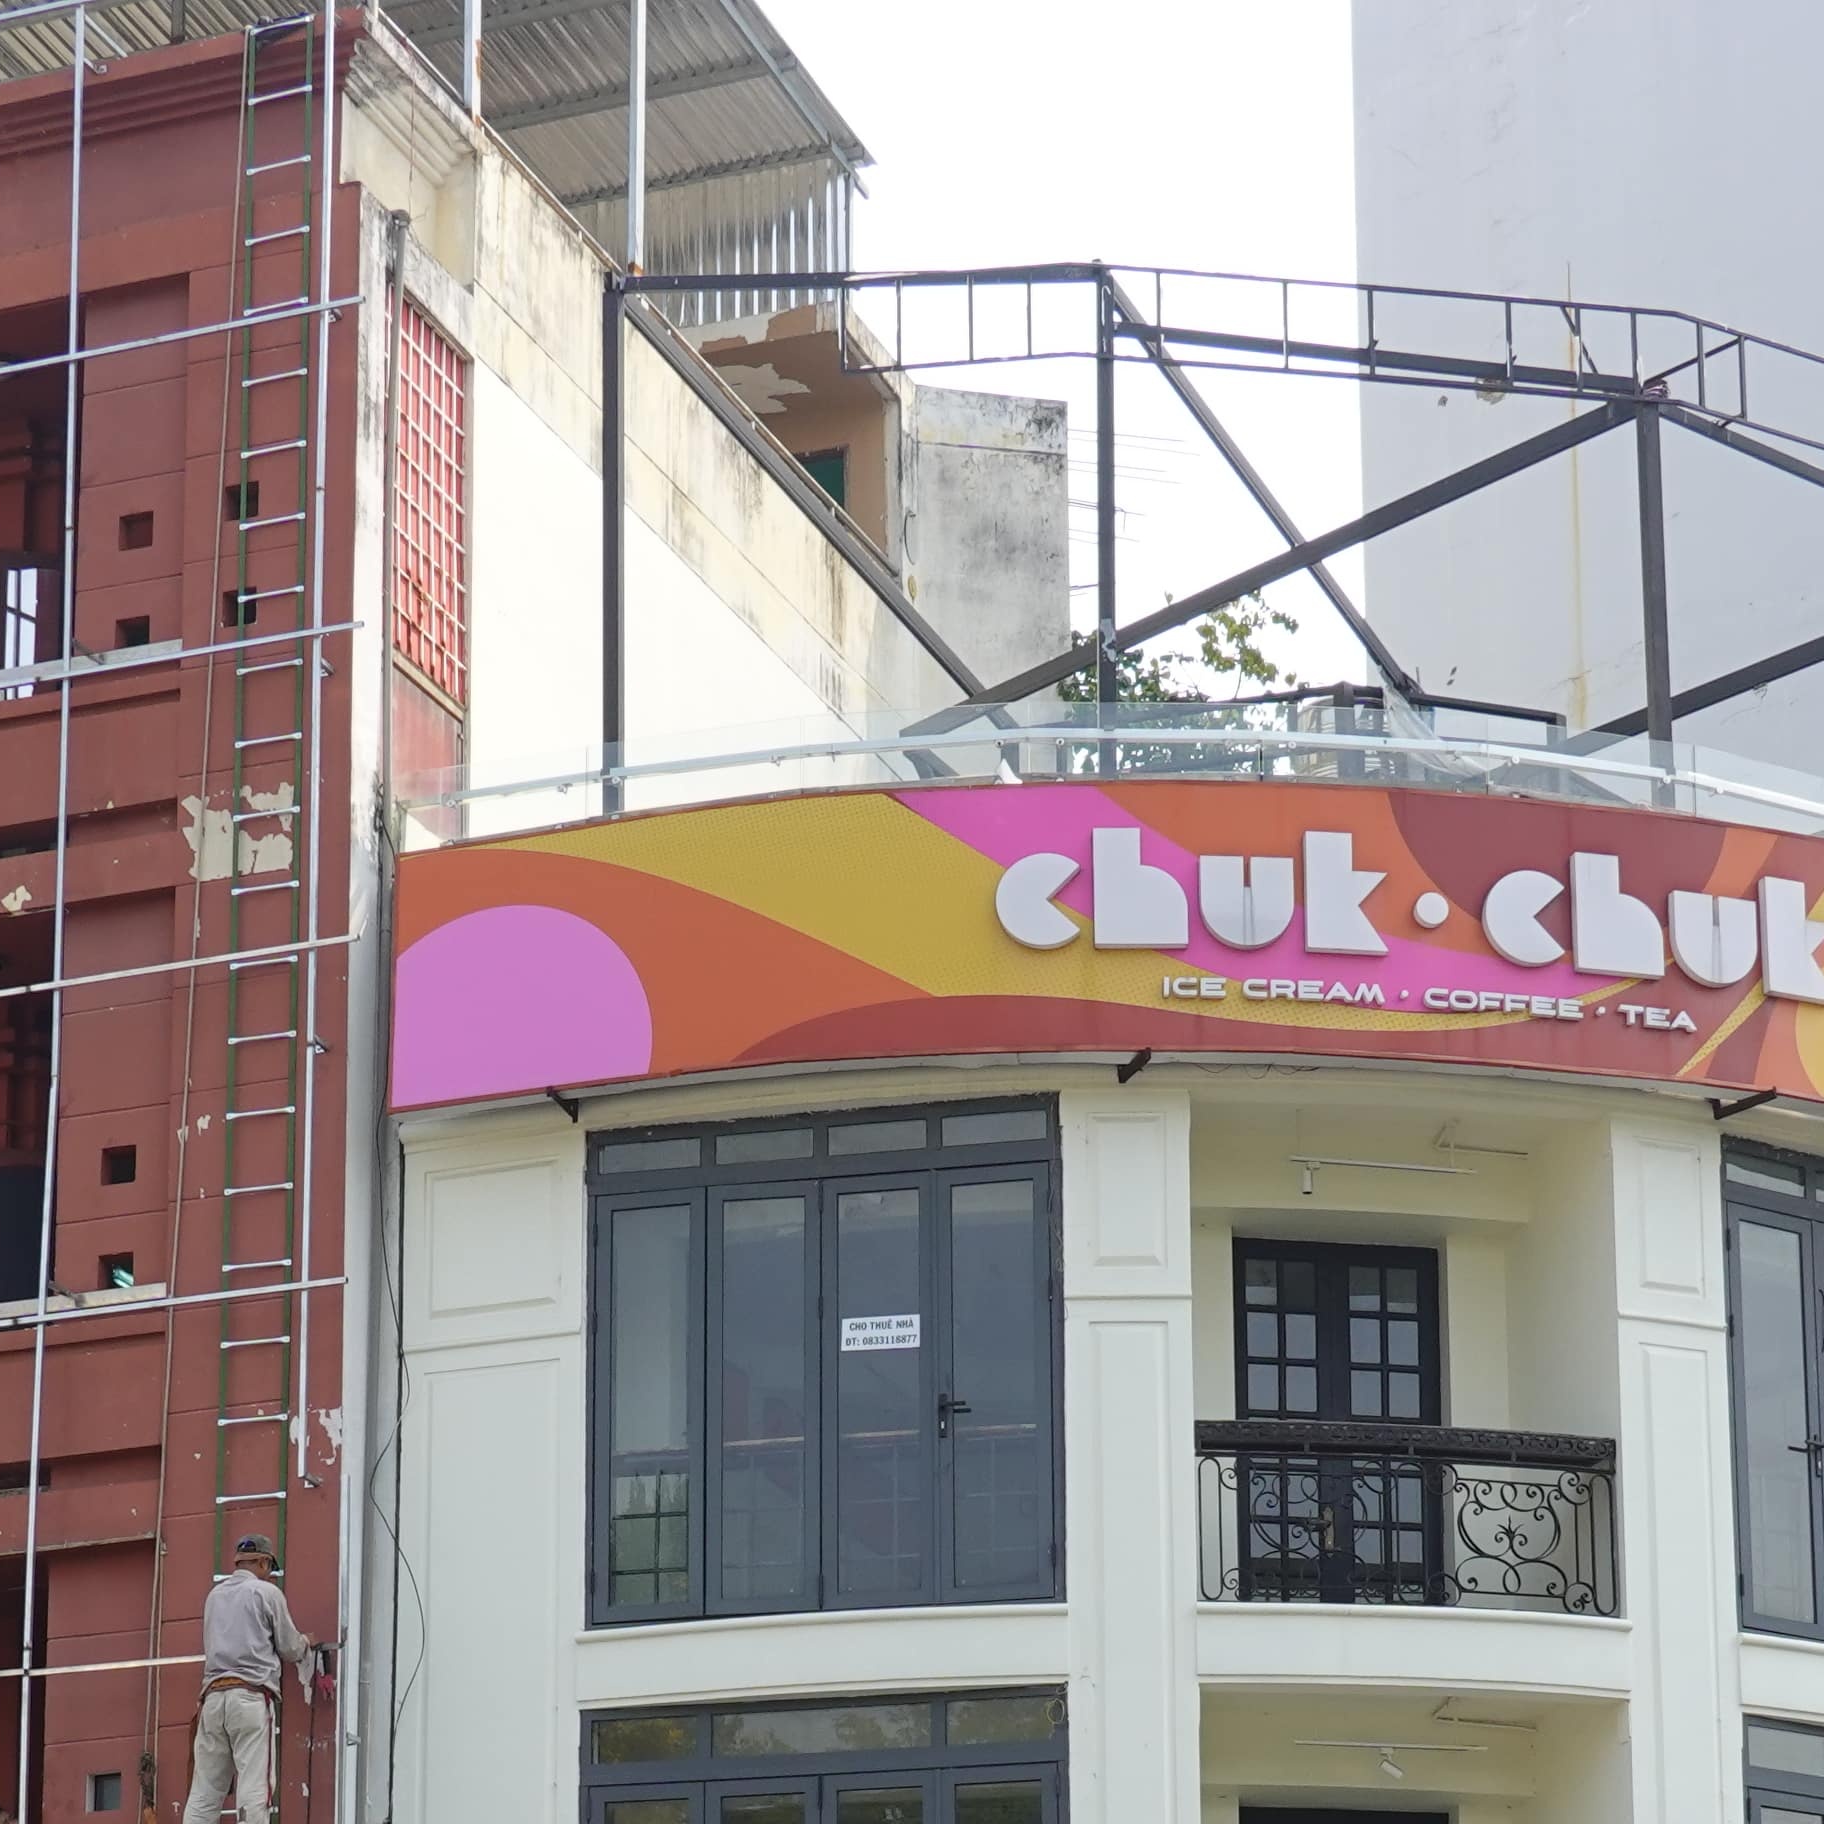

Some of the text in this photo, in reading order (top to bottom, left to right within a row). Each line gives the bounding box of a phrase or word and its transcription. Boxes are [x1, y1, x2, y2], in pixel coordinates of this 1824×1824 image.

[995, 827, 1390, 956] chuk
[1162, 977, 1697, 1033] ICE CREAM COFFEE TEA
[849, 1318, 914, 1331] CHO THUÊ NHÀ
